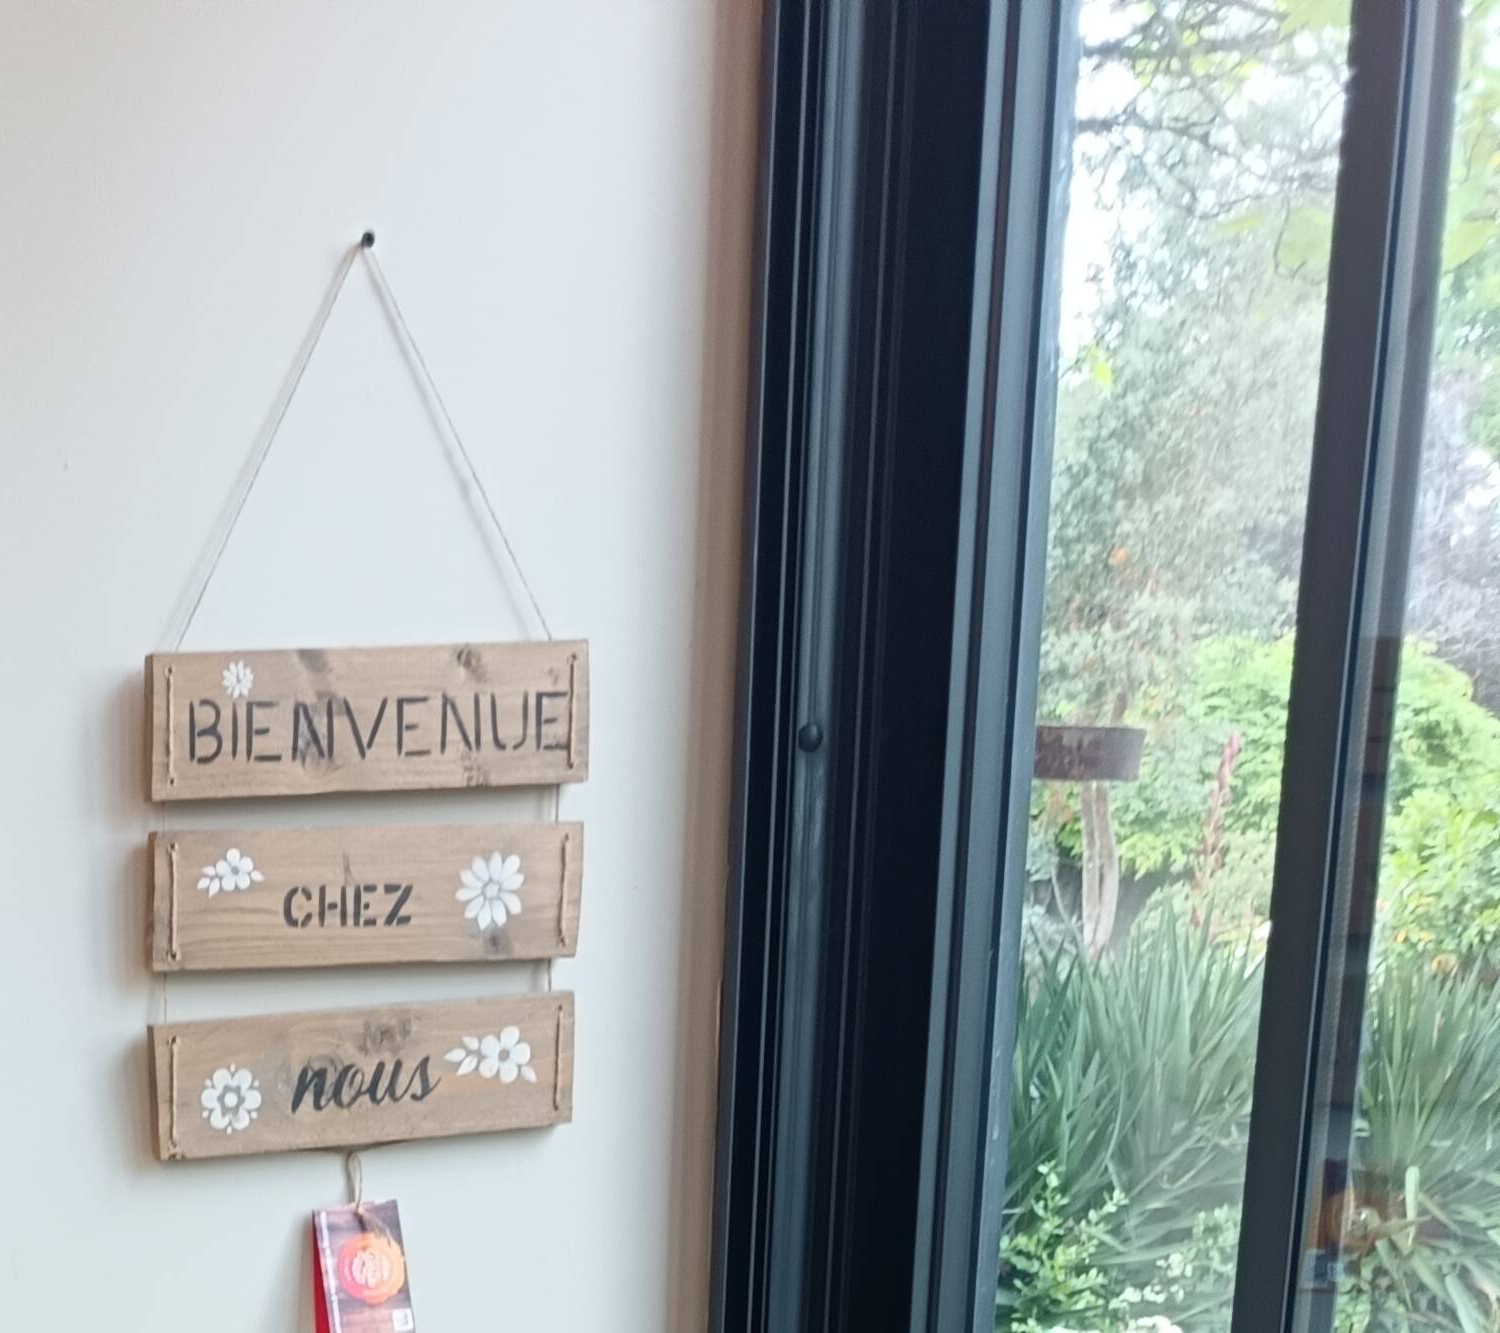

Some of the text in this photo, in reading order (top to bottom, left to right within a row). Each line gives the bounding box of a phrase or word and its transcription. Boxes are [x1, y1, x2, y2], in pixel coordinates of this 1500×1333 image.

[187, 691, 569, 764] BIENVENUE
[283, 883, 412, 928] CHEZ
[290, 1053, 441, 1113] nous
